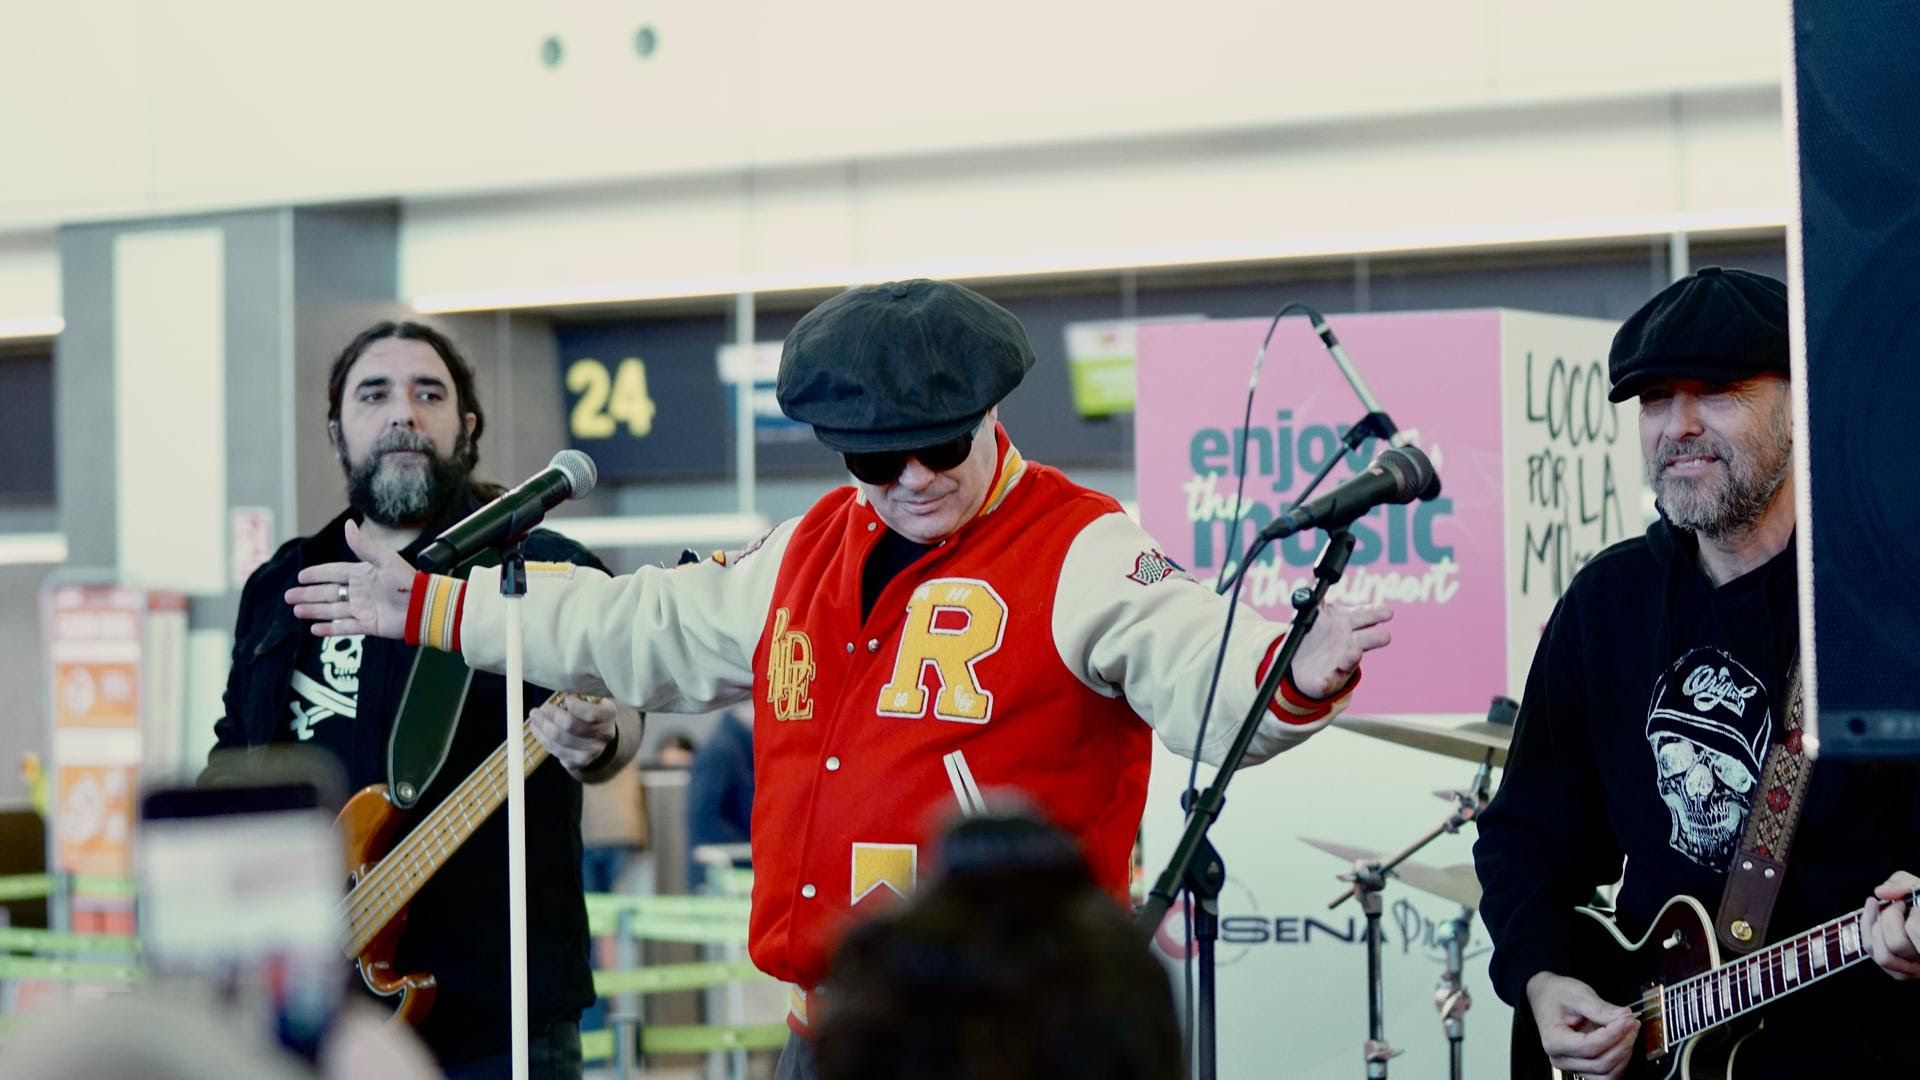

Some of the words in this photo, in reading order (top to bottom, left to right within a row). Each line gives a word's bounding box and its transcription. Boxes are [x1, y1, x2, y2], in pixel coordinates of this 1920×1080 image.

[566, 356, 656, 439] 24
[1184, 470, 1254, 523] the
[1577, 453, 1625, 545] LA
[876, 577, 1009, 724] R
